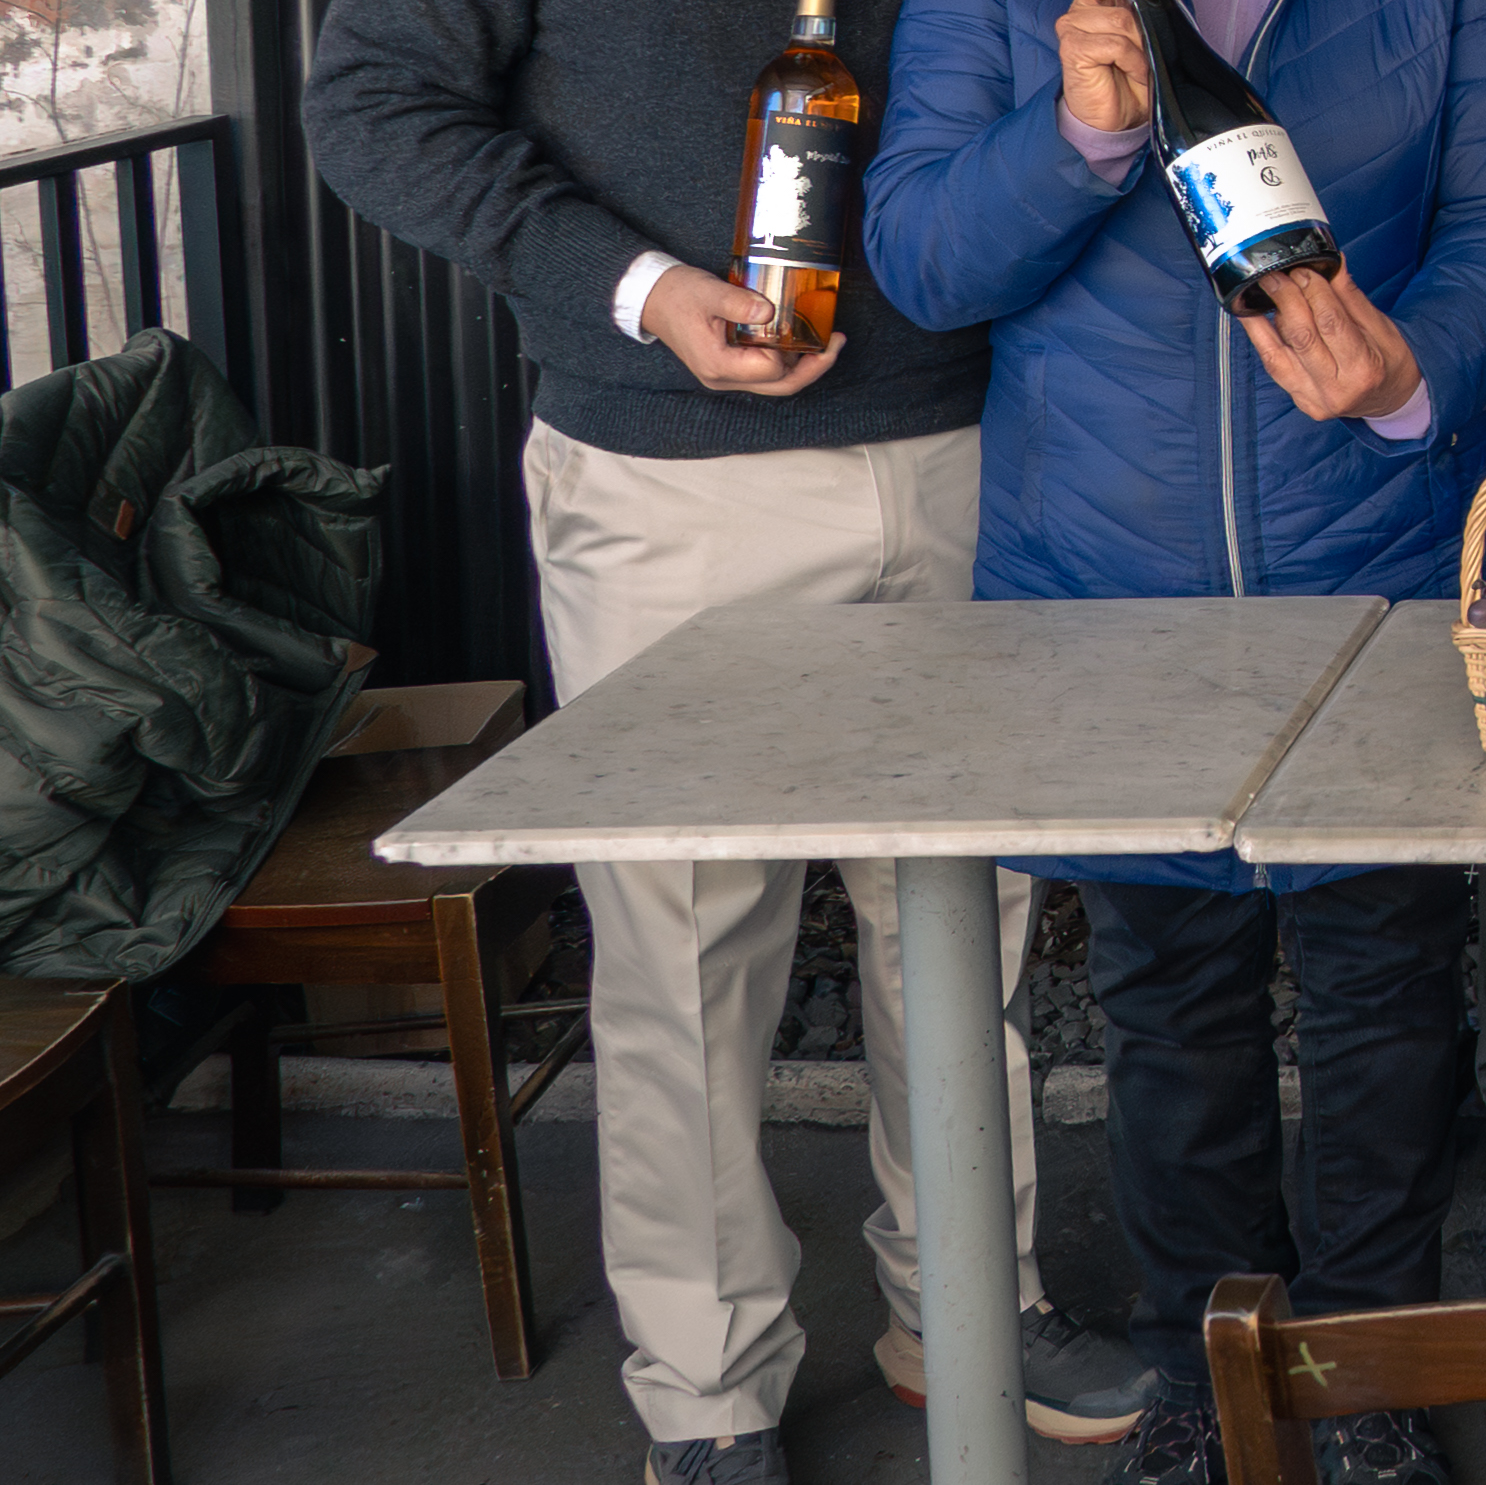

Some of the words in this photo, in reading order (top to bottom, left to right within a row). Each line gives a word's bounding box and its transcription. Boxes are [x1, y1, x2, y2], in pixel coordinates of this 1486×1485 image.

[775, 116, 802, 126] VIÑA
[1206, 138, 1233, 151] VIÑA
[1236, 132, 1248, 141] EL
